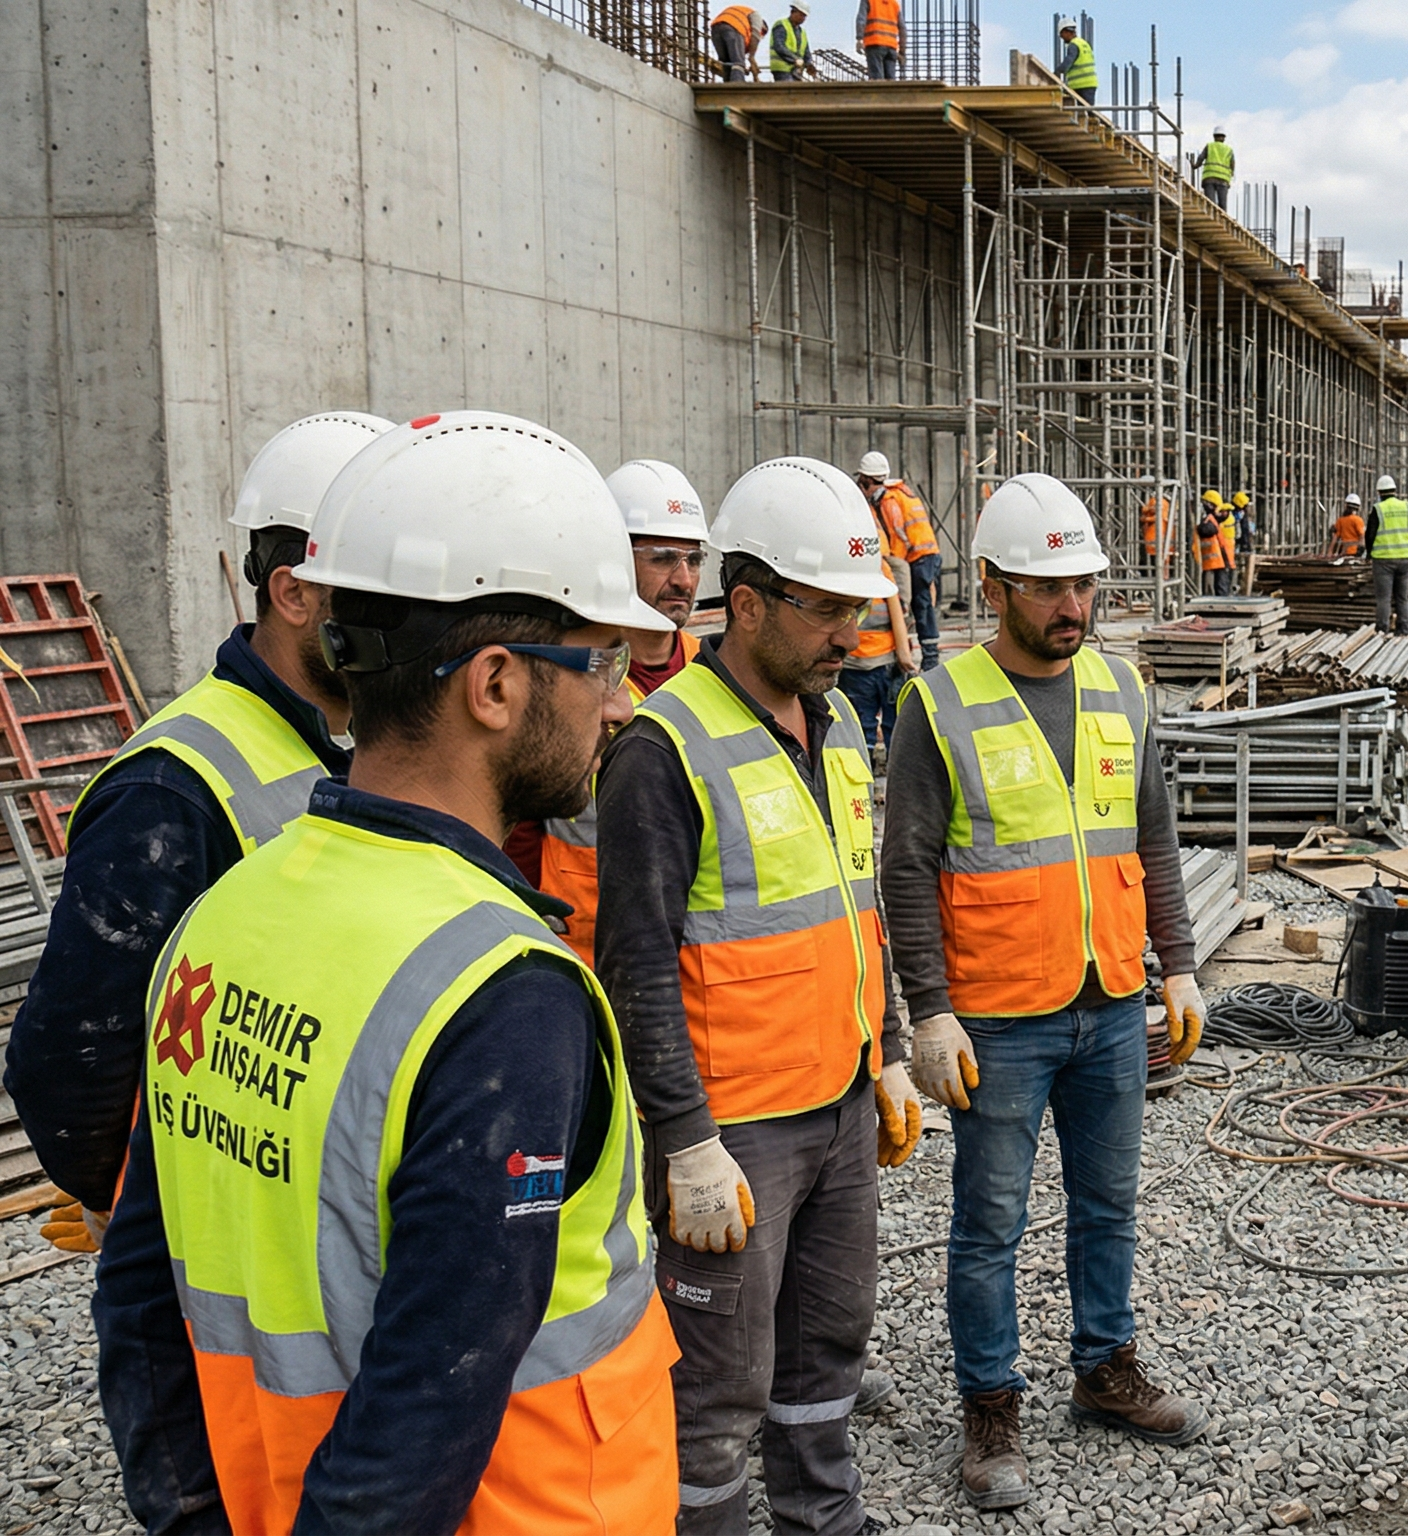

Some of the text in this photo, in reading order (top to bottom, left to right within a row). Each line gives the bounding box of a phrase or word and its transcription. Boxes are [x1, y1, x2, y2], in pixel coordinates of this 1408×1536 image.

[218, 981, 322, 1065] DEMİR
[210, 1029, 307, 1111] İNŞAAT
[153, 1082, 291, 1184] İŞ ÜVENLİĞİ
